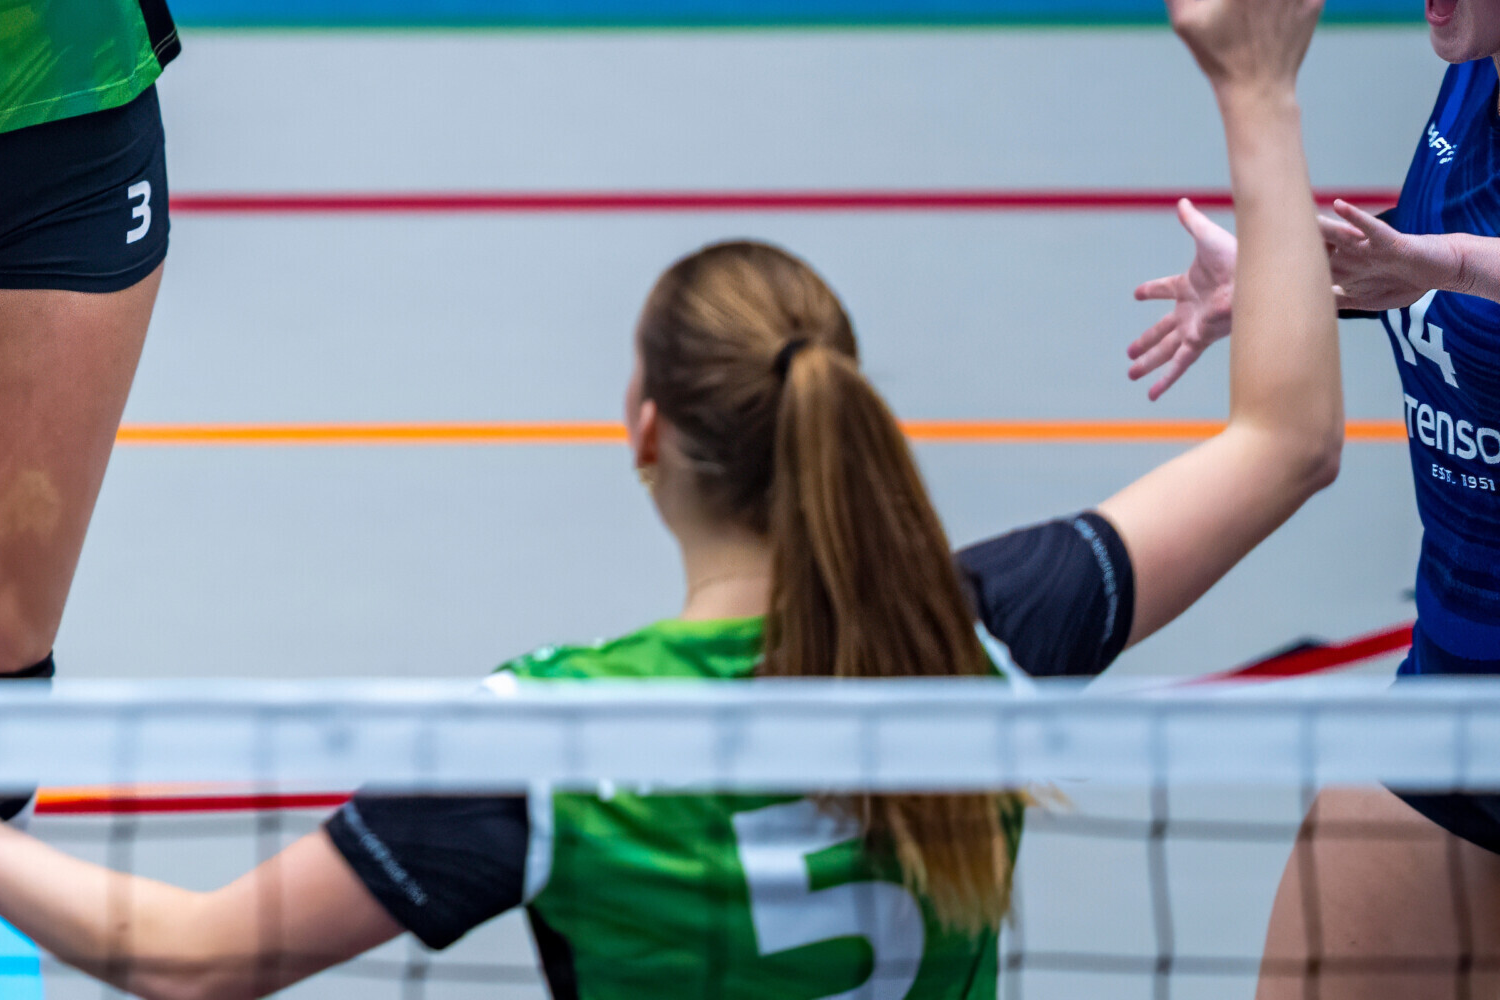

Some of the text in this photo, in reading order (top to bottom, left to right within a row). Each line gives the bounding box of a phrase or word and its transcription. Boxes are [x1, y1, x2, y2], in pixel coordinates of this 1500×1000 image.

[126, 180, 152, 245] 3
[1387, 288, 1460, 390] 14
[1431, 463, 1496, 492] EST. 1951
[731, 799, 926, 1000] 5
